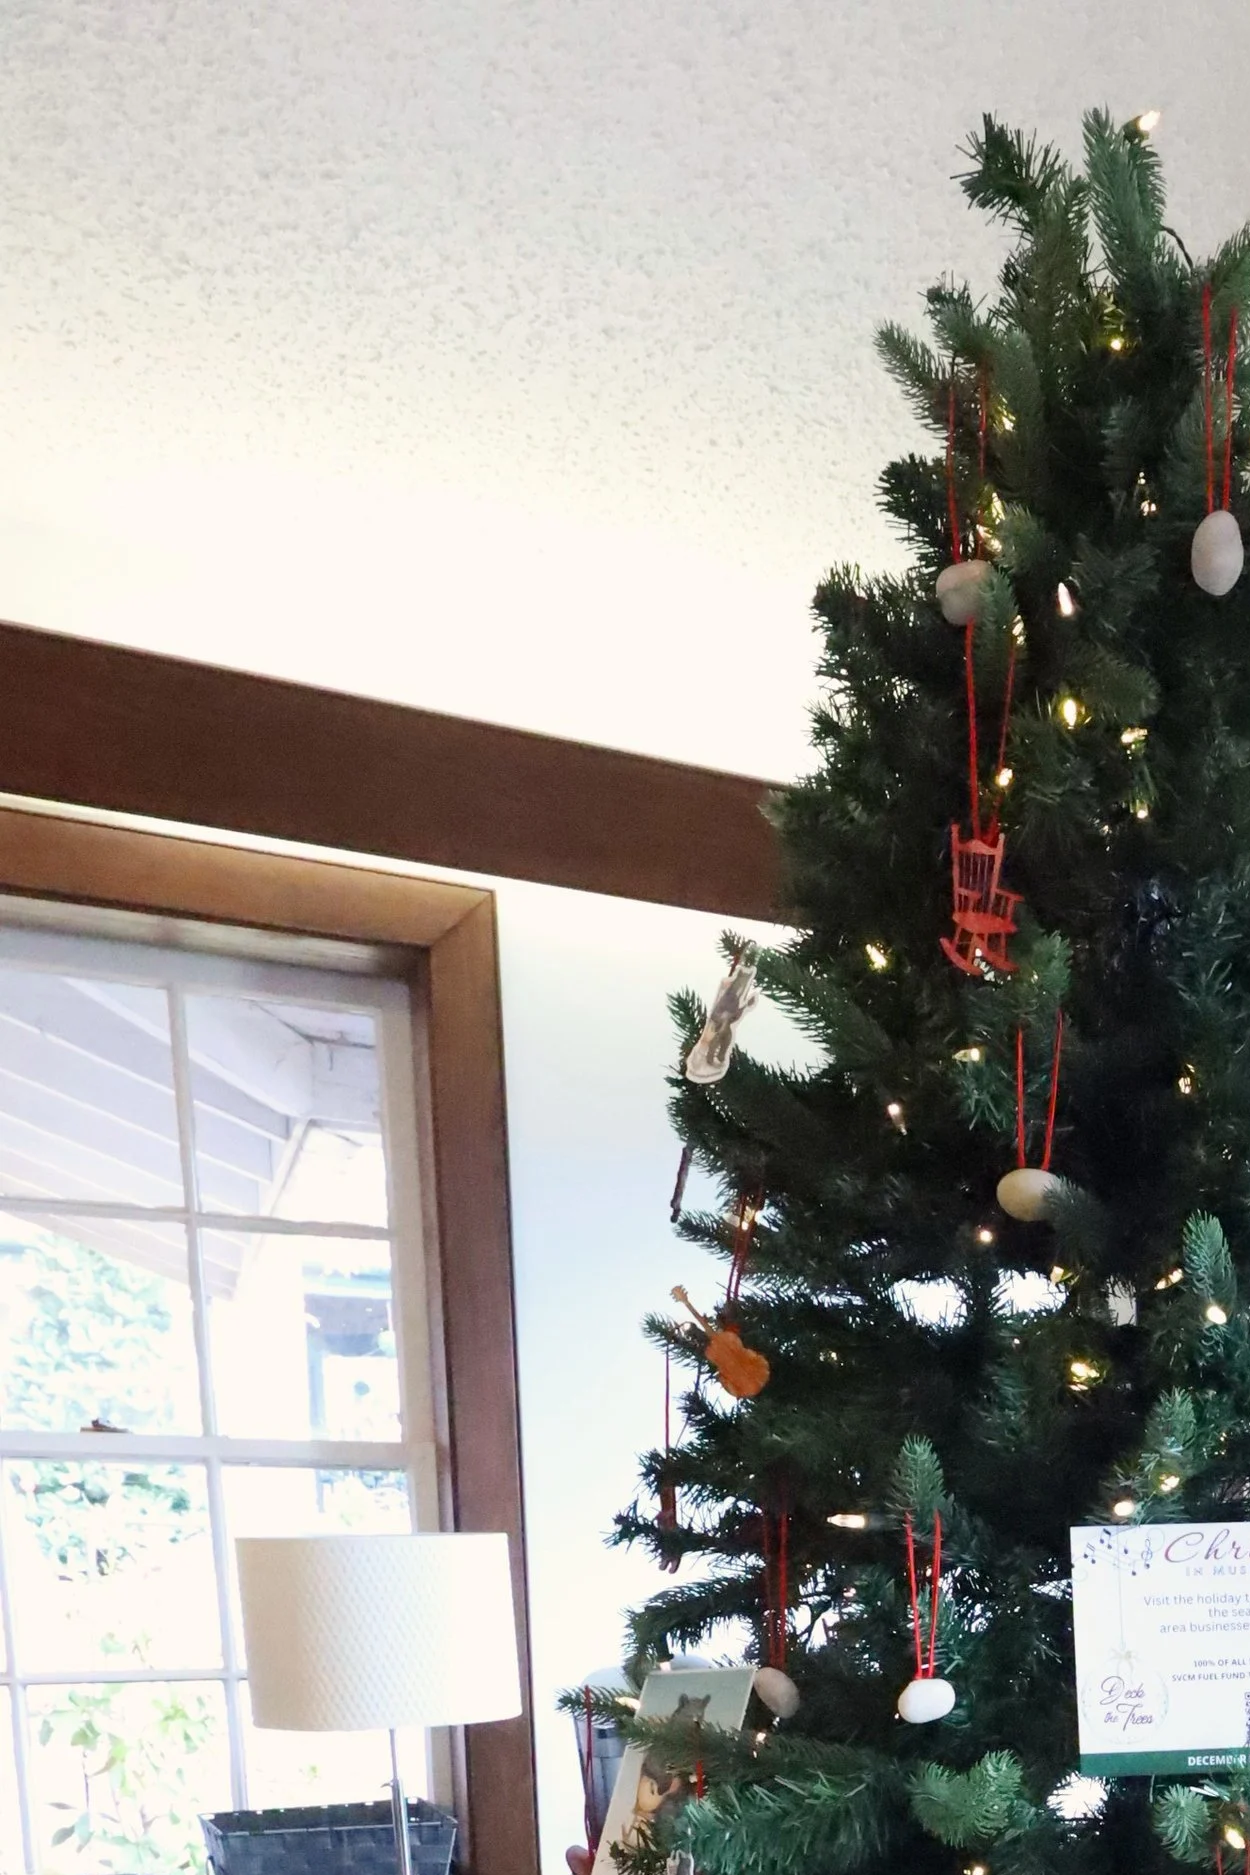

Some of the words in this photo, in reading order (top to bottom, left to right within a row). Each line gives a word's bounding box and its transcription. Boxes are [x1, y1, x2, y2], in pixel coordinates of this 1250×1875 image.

[1185, 1567, 1203, 1577] IN
[1143, 1595, 1170, 1606] Visit
[1173, 1595, 1194, 1605] the
[1197, 1592, 1241, 1607] holiday
[1208, 1606, 1229, 1618] the
[1159, 1623, 1187, 1634] area
[1193, 1659, 1215, 1668] 100%
[1217, 1658, 1230, 1667] OF
[1231, 1657, 1247, 1666] ALL
[1172, 1673, 1196, 1682] SVCM
[1198, 1672, 1219, 1681] FUEL
[1221, 1671, 1246, 1680] FUND
[1099, 1675, 1145, 1705] Deck
[1116, 1703, 1154, 1732] Trees
[1187, 1753, 1247, 1767] DECEMBR
